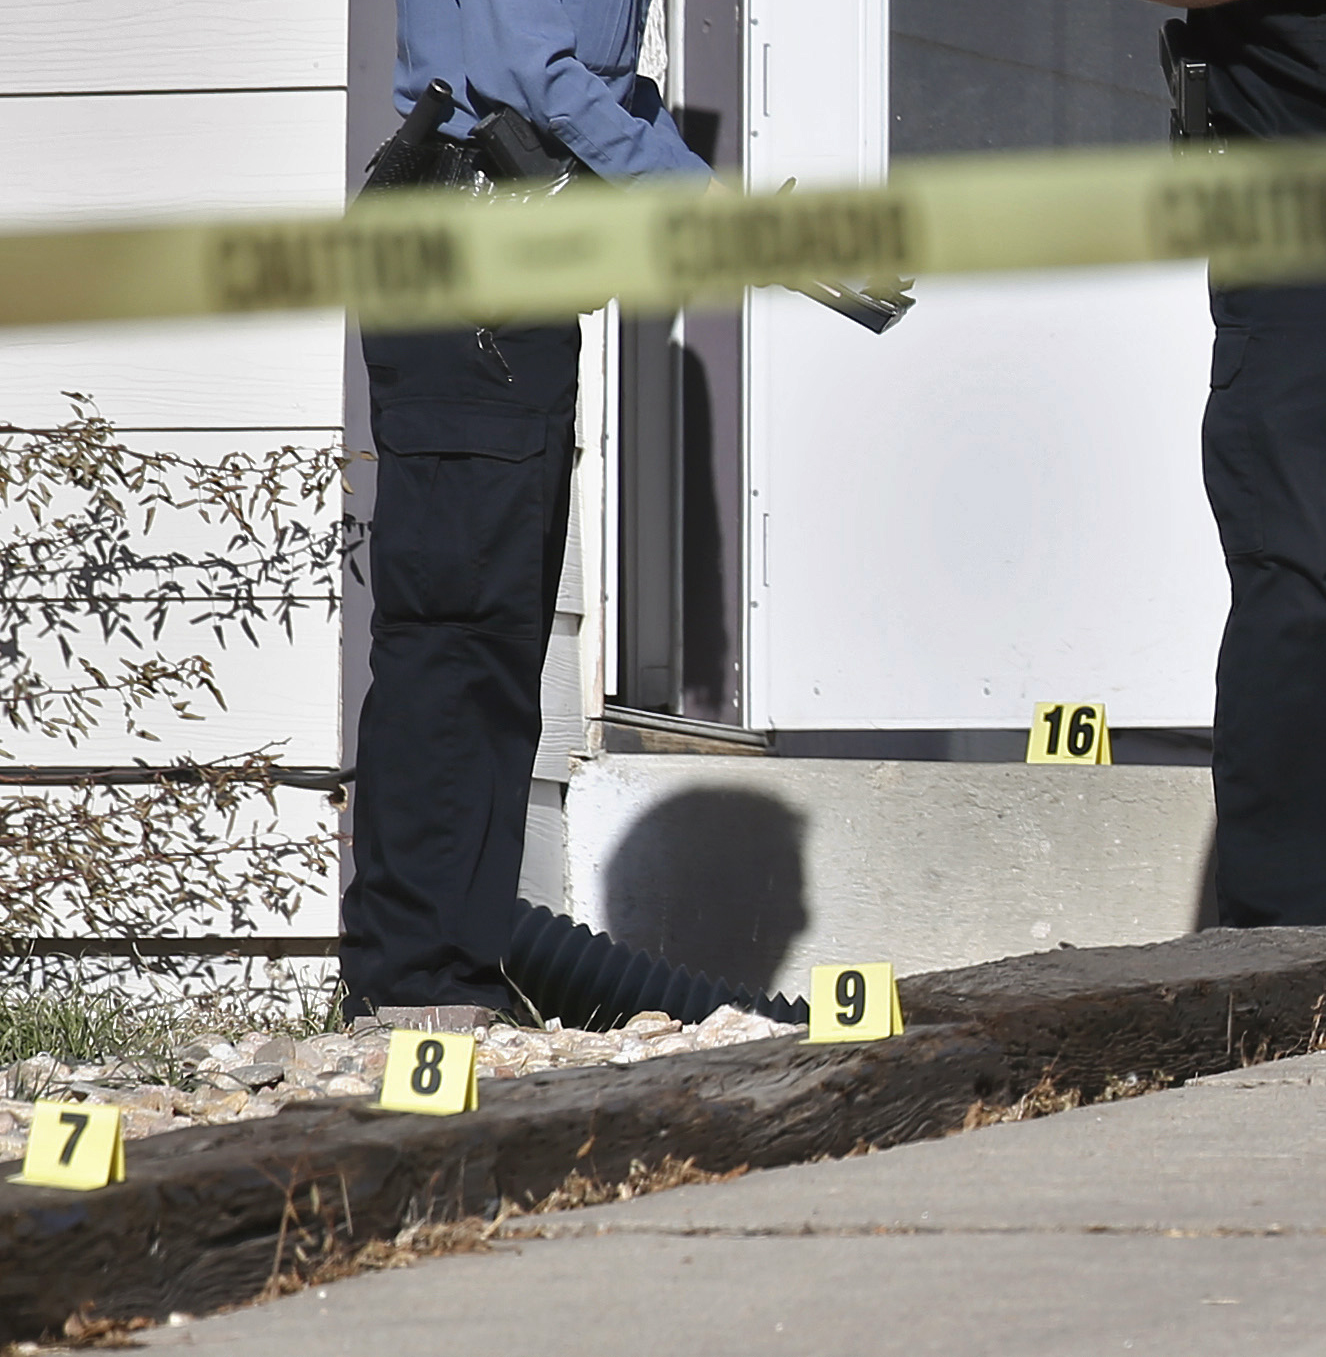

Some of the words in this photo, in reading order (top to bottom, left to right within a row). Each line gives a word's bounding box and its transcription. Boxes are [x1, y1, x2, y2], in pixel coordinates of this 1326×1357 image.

[1043, 705, 1096, 757] 16
[835, 969, 866, 1026] 9
[411, 1039, 445, 1096] 8
[59, 1112, 89, 1166] 7
